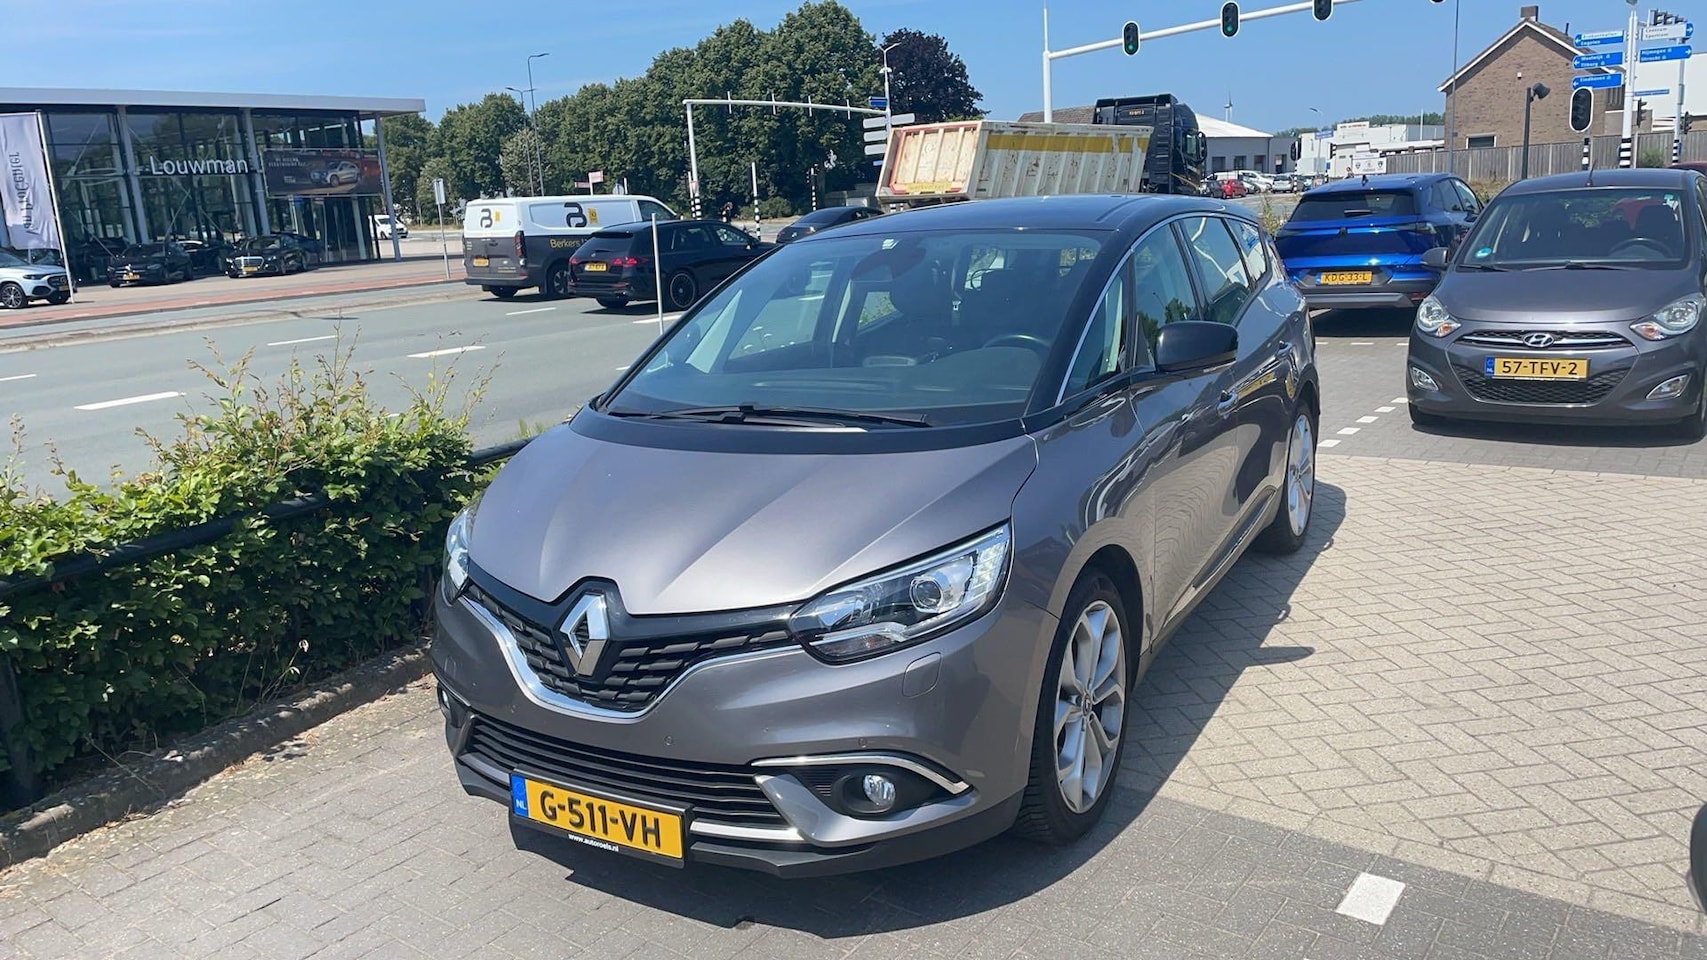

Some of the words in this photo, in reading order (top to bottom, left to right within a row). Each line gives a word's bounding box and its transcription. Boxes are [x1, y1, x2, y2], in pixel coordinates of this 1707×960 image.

[149, 155, 249, 175] Louwman
[550, 238, 581, 248] Berkers
[1324, 273, 1368, 281] KDG-33-L
[1502, 361, 1577, 375] 57-TFV-2
[516, 800, 527, 810] NL
[540, 791, 661, 847] G-511-VH
[568, 834, 619, 852] www.autoroels.nl
